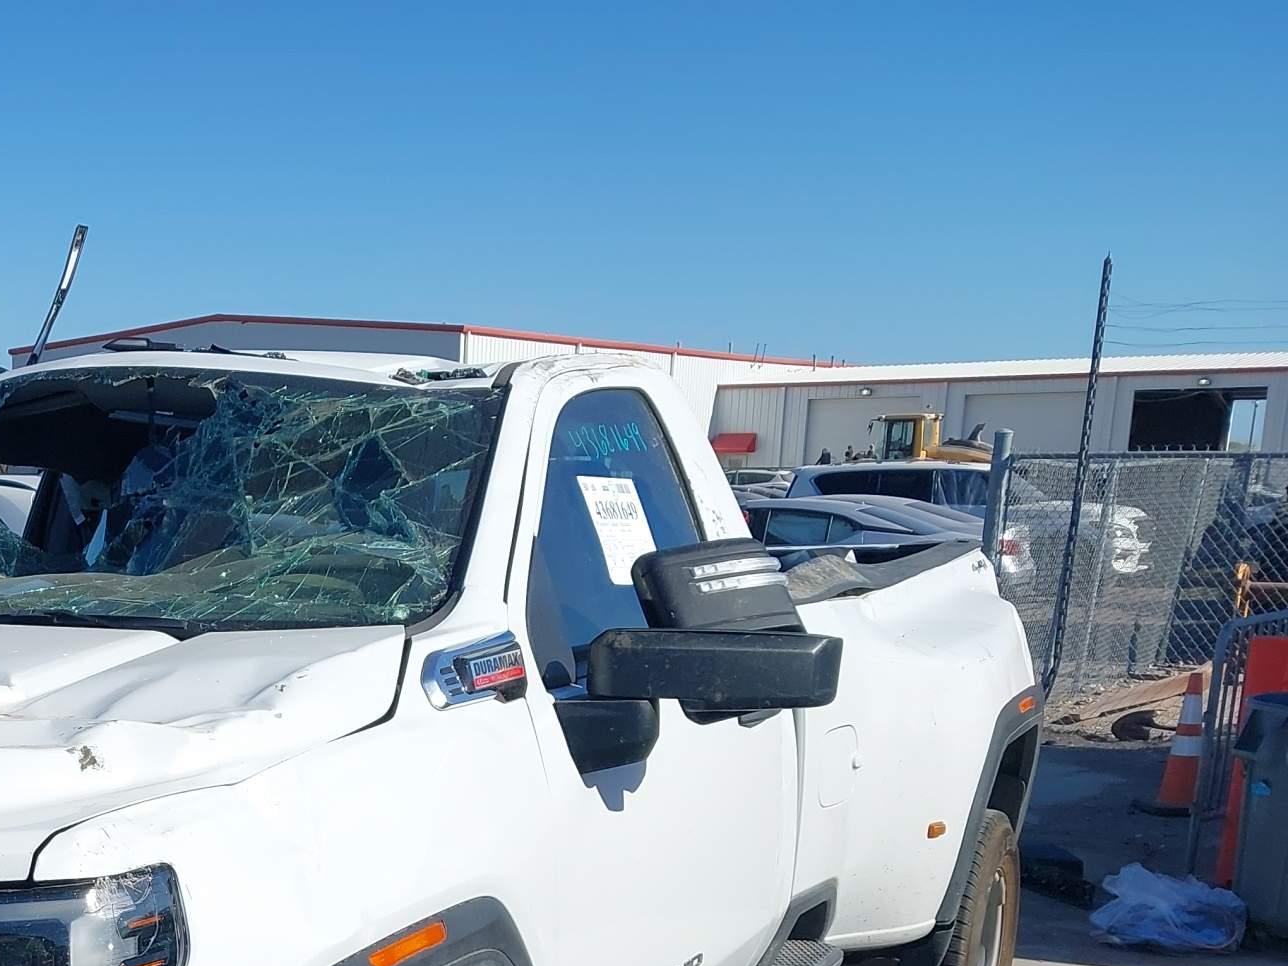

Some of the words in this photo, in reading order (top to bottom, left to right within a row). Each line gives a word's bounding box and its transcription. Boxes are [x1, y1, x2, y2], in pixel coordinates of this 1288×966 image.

[569, 422, 648, 458] 43681649
[594, 500, 639, 520] 43681649
[473, 651, 520, 676] DURAMAX
